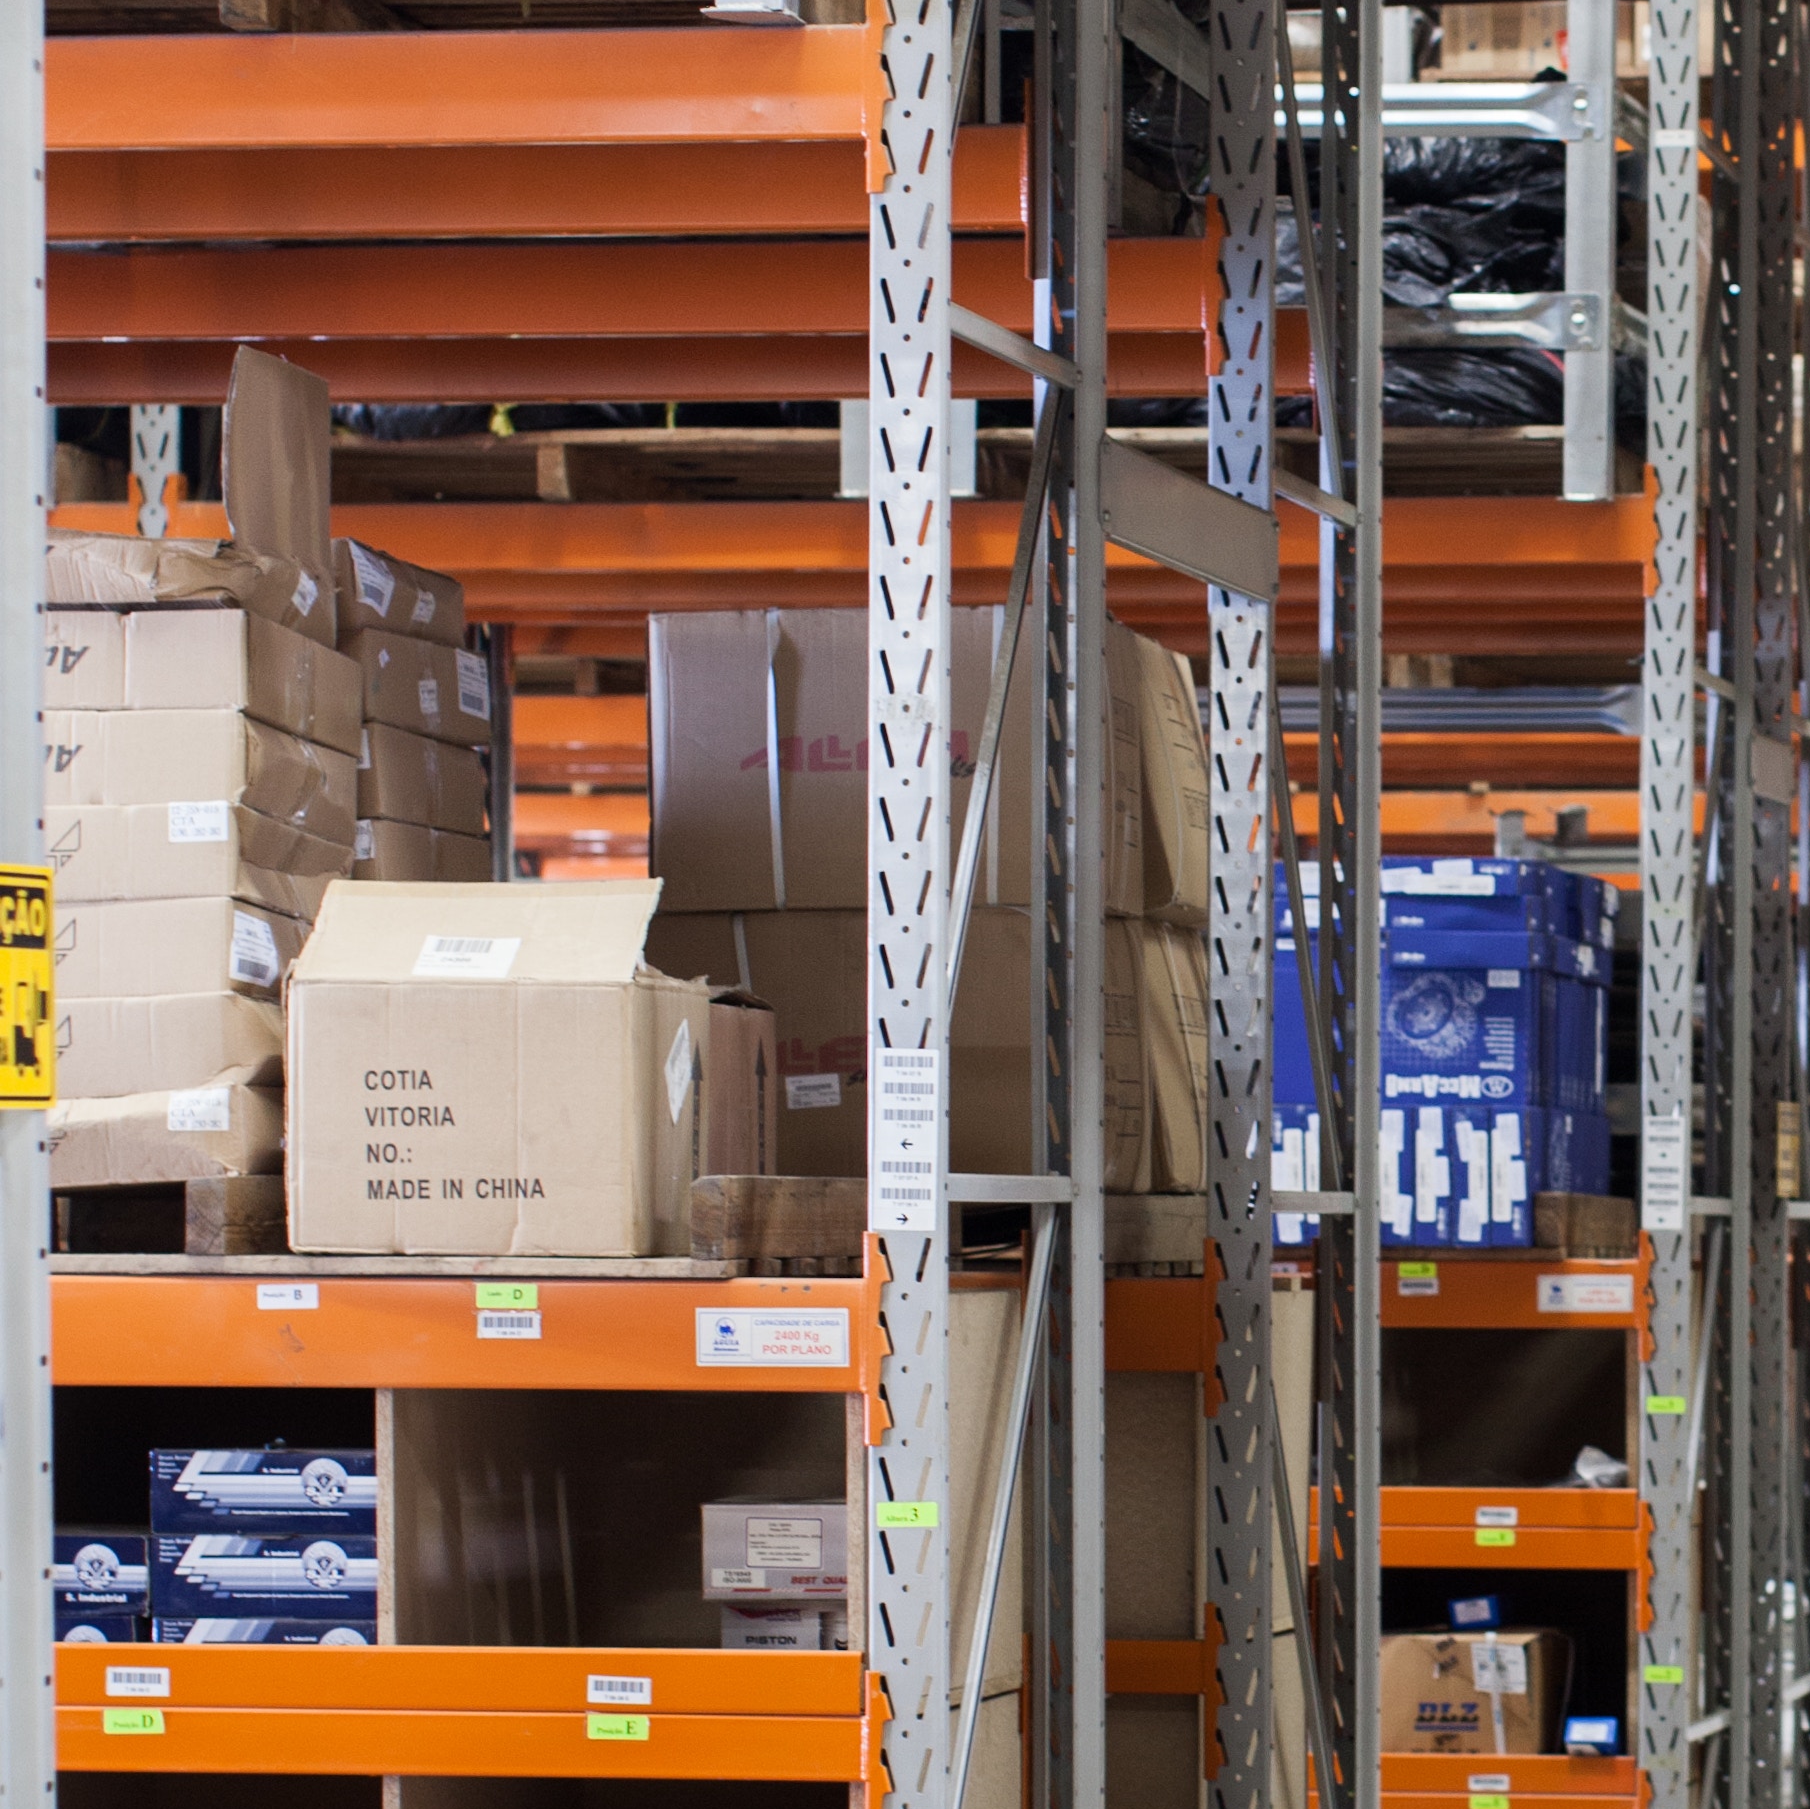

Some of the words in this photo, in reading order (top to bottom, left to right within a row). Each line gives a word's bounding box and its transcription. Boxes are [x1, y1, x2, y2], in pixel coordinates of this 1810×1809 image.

[364, 1070, 433, 1090] COTIA
[365, 1106, 455, 1126] VITORIA
[366, 1143, 412, 1163] NO.:
[367, 1180, 431, 1199] MADE
[442, 1179, 463, 1199] IN
[475, 1178, 545, 1199] CHINA
[294, 1289, 303, 1300] B
[513, 1289, 523, 1300] D
[804, 1331, 820, 1343] Kg
[762, 1345, 788, 1354] POR
[791, 1345, 832, 1355] PLANO
[910, 1507, 919, 1522] 3
[791, 1576, 817, 1584] BEST
[78, 1592, 127, 1603] Industrial
[746, 1636, 797, 1645] PISTON
[142, 1714, 154, 1728] D
[626, 1720, 637, 1735] E
